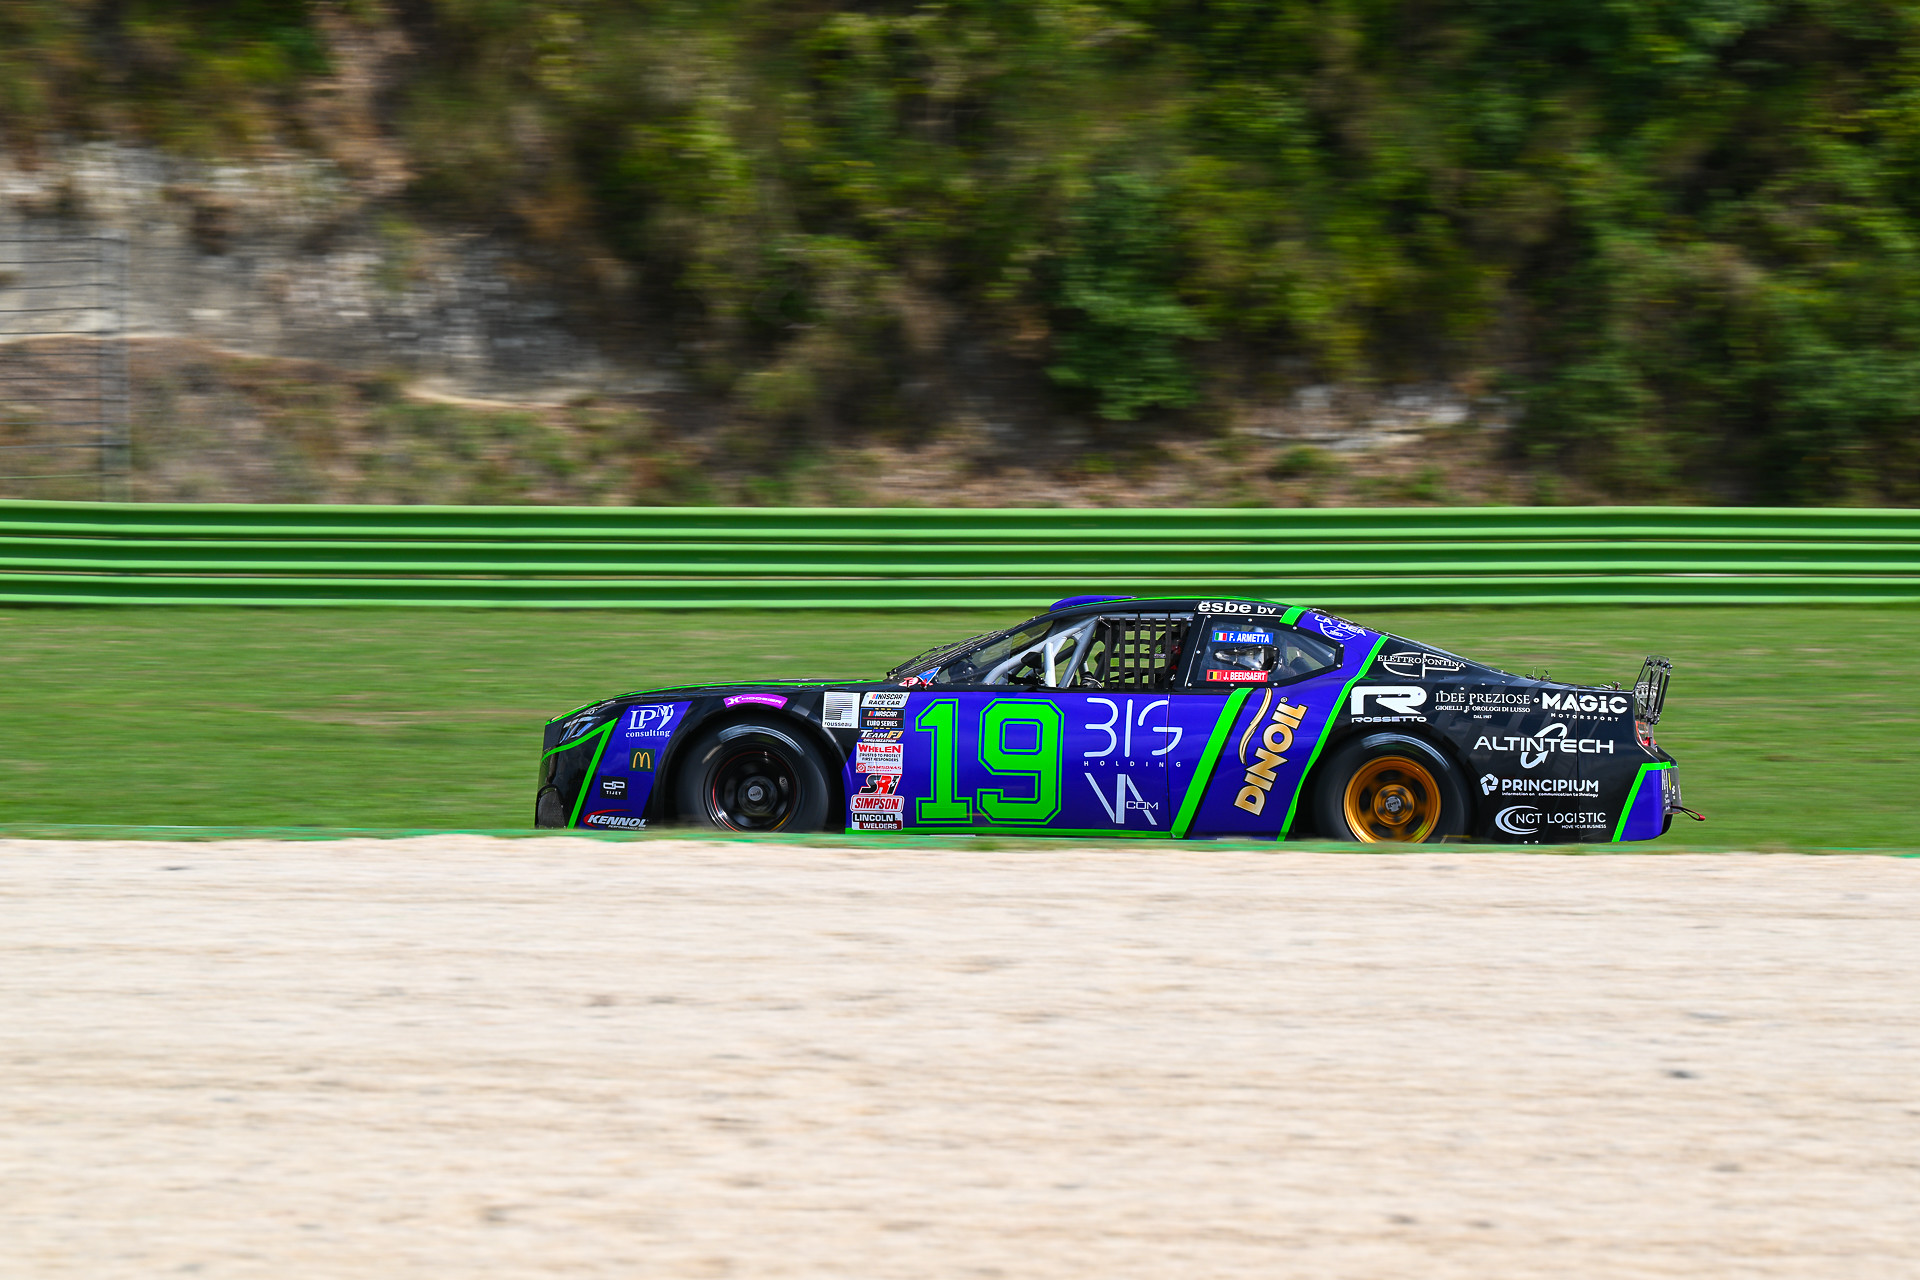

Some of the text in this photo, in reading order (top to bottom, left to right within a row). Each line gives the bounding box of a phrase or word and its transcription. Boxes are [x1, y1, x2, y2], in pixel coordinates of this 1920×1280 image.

[1314, 615, 1333, 625] LA
[1337, 622, 1367, 637] DEA
[1229, 633, 1270, 643] F. ARMETTA
[1223, 671, 1266, 681] J. BEEUSAERT
[1435, 690, 1531, 705] IDEE PREZIOSE
[1351, 715, 1427, 723] ROSSETTO
[1550, 713, 1619, 721] MOTORSPORT
[1473, 736, 1614, 754] ALTINTECH
[915, 698, 1064, 825] 19
[1234, 702, 1308, 816] DINOIL
[1501, 779, 1599, 792] PRINCIPIUM
[854, 797, 900, 809] SIMPSON
[587, 814, 646, 827] KENNOL
[854, 814, 893, 822] LINCOLN
[1515, 812, 1606, 824] NGT LOGISTIC
